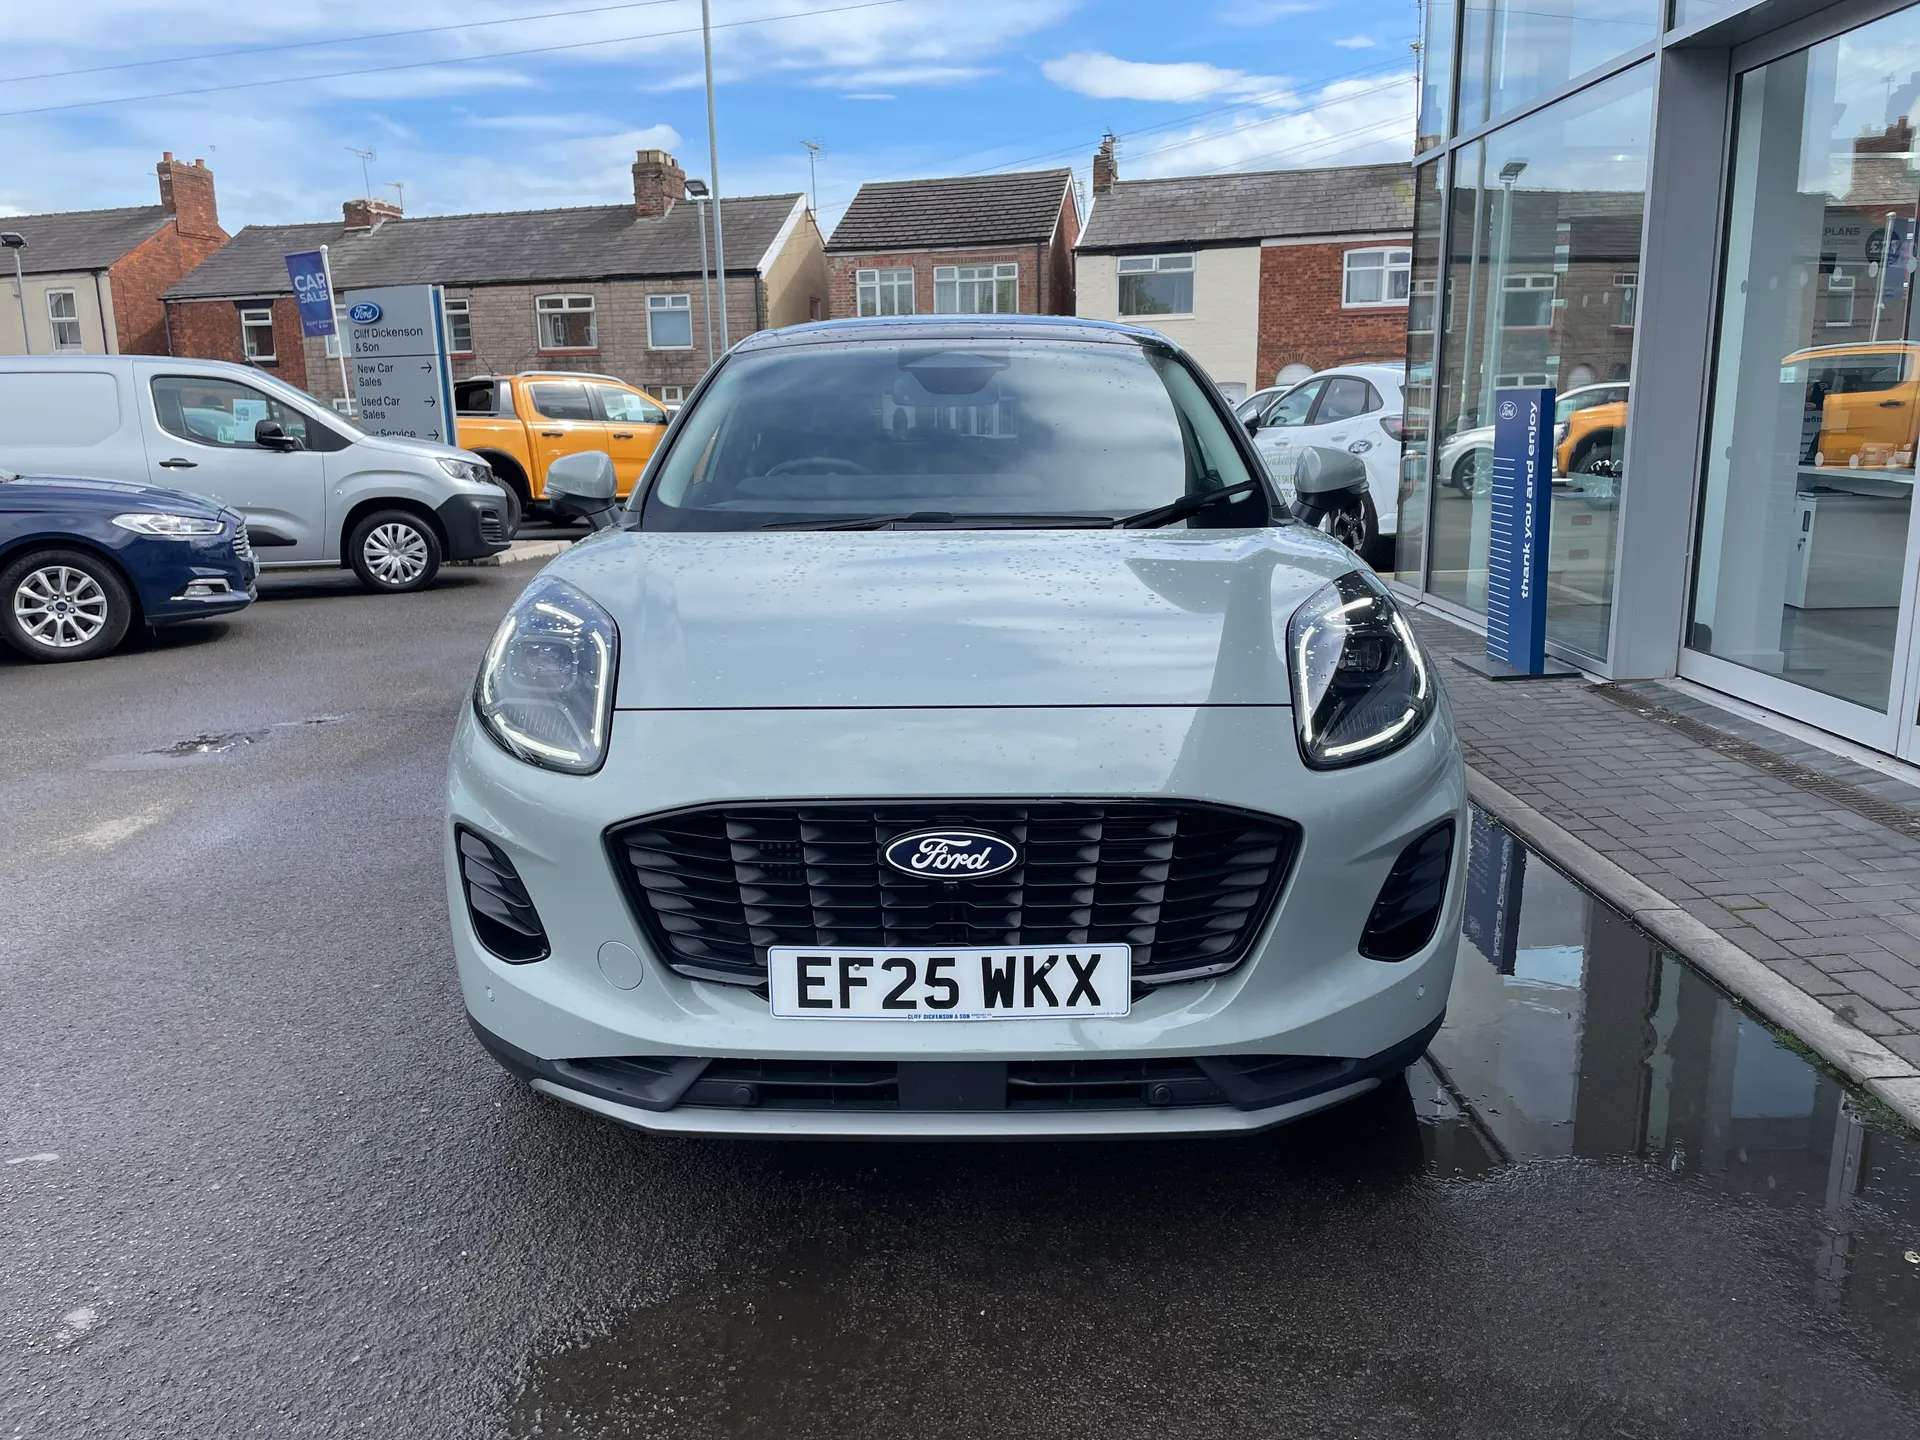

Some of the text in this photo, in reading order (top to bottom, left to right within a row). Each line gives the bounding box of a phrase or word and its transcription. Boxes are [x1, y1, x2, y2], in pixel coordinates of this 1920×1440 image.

[294, 272, 327, 292] CAR
[353, 327, 424, 339] Cliff Dickenson
[355, 342, 380, 353] & Son
[357, 362, 394, 374] New Car
[359, 377, 382, 387] Sales
[361, 396, 401, 407] Used Car
[362, 409, 386, 420] Sales
[1521, 400, 1538, 599] thank you and enjoy
[796, 953, 1102, 1010] EF25 WKX
